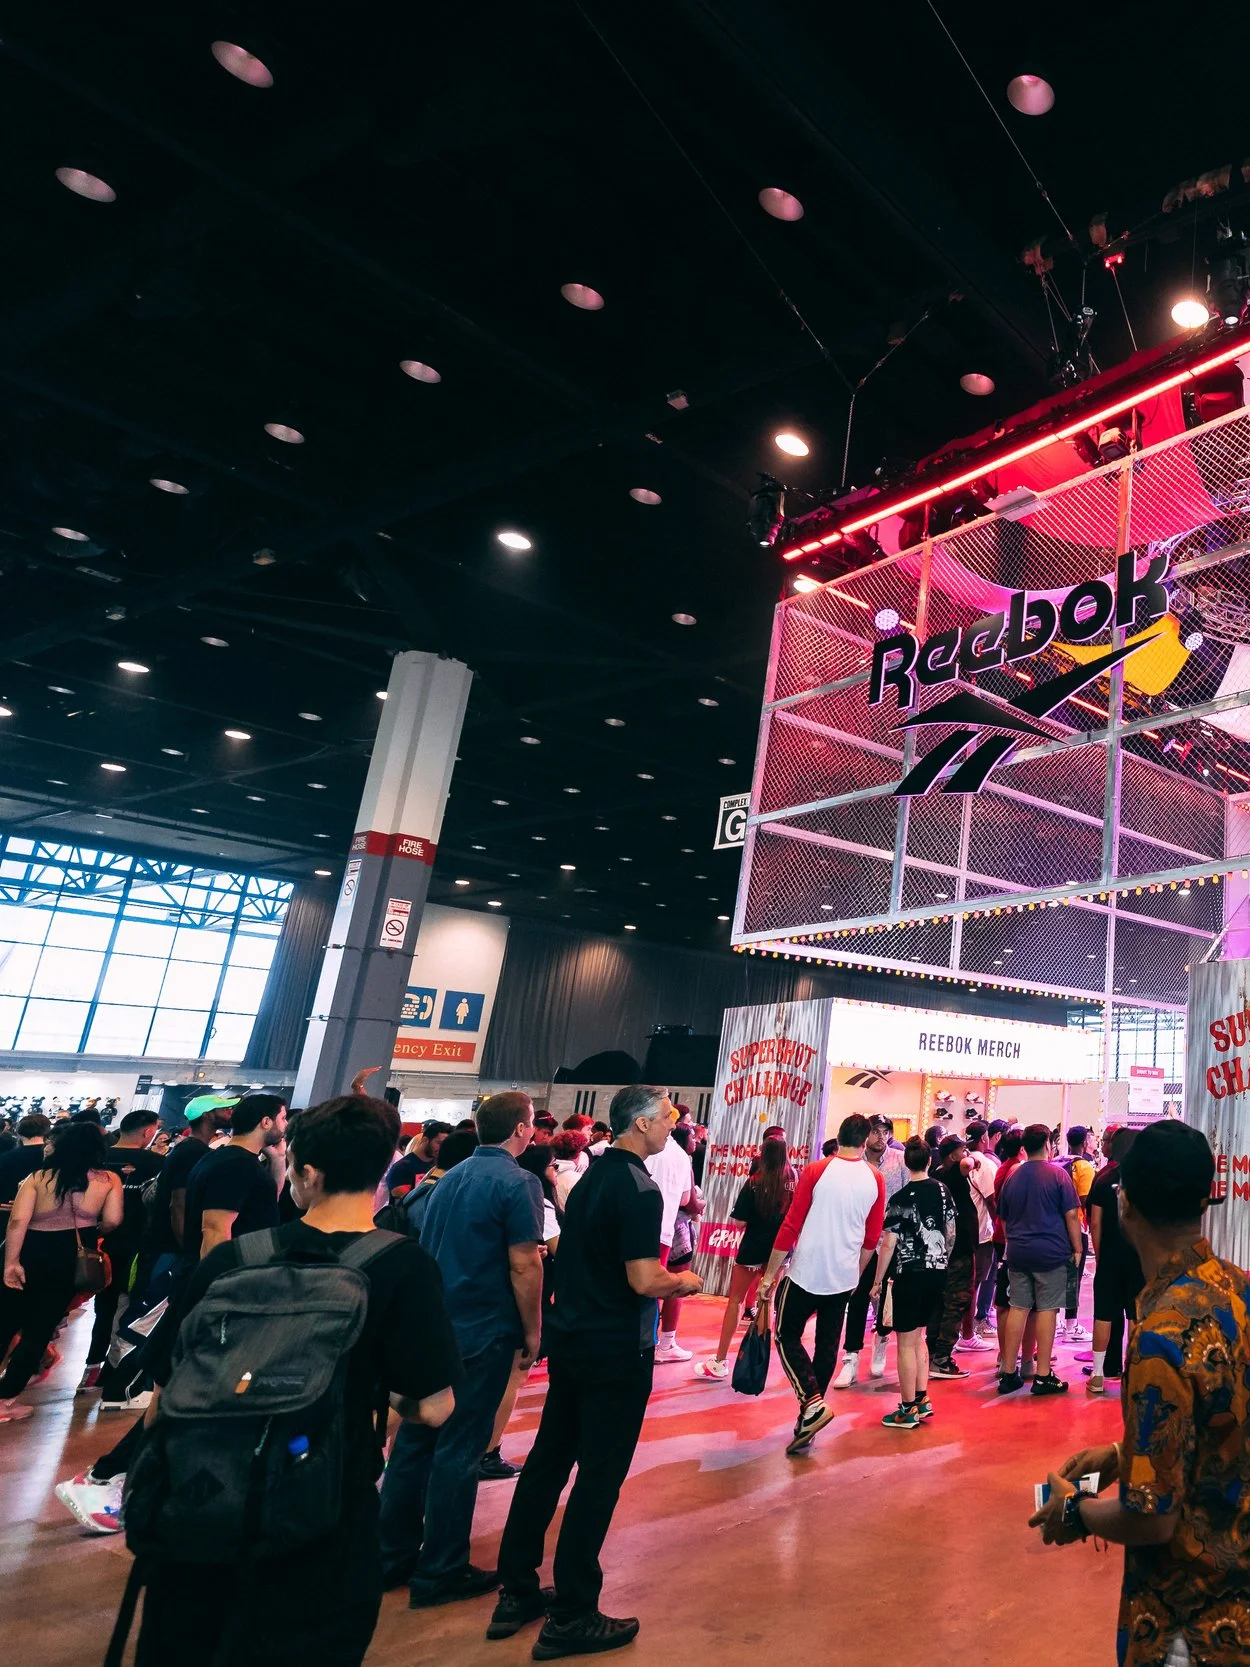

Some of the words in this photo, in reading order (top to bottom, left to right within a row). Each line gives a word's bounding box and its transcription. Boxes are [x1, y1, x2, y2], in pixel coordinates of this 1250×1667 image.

[868, 550, 1170, 711] Reebok
[723, 798, 747, 809] COMPLEX
[724, 809, 747, 841] G
[352, 842, 367, 850] HOSE
[355, 836, 367, 844] FIRE
[402, 839, 423, 849] FIRE
[398, 845, 424, 856] HOSE
[393, 1043, 427, 1057] ency
[432, 1043, 462, 1057] Exit
[919, 1032, 972, 1055] REEBOK
[978, 1038, 1020, 1059] MERCH
[730, 1039, 817, 1073] SUPERSHOT
[724, 1071, 812, 1106] CHALLENGE
[710, 1144, 729, 1158] THE
[789, 1145, 809, 1159] AKE
[708, 1161, 726, 1176] THE
[730, 1161, 750, 1177] MOR
[708, 1228, 746, 1249] GRAN
